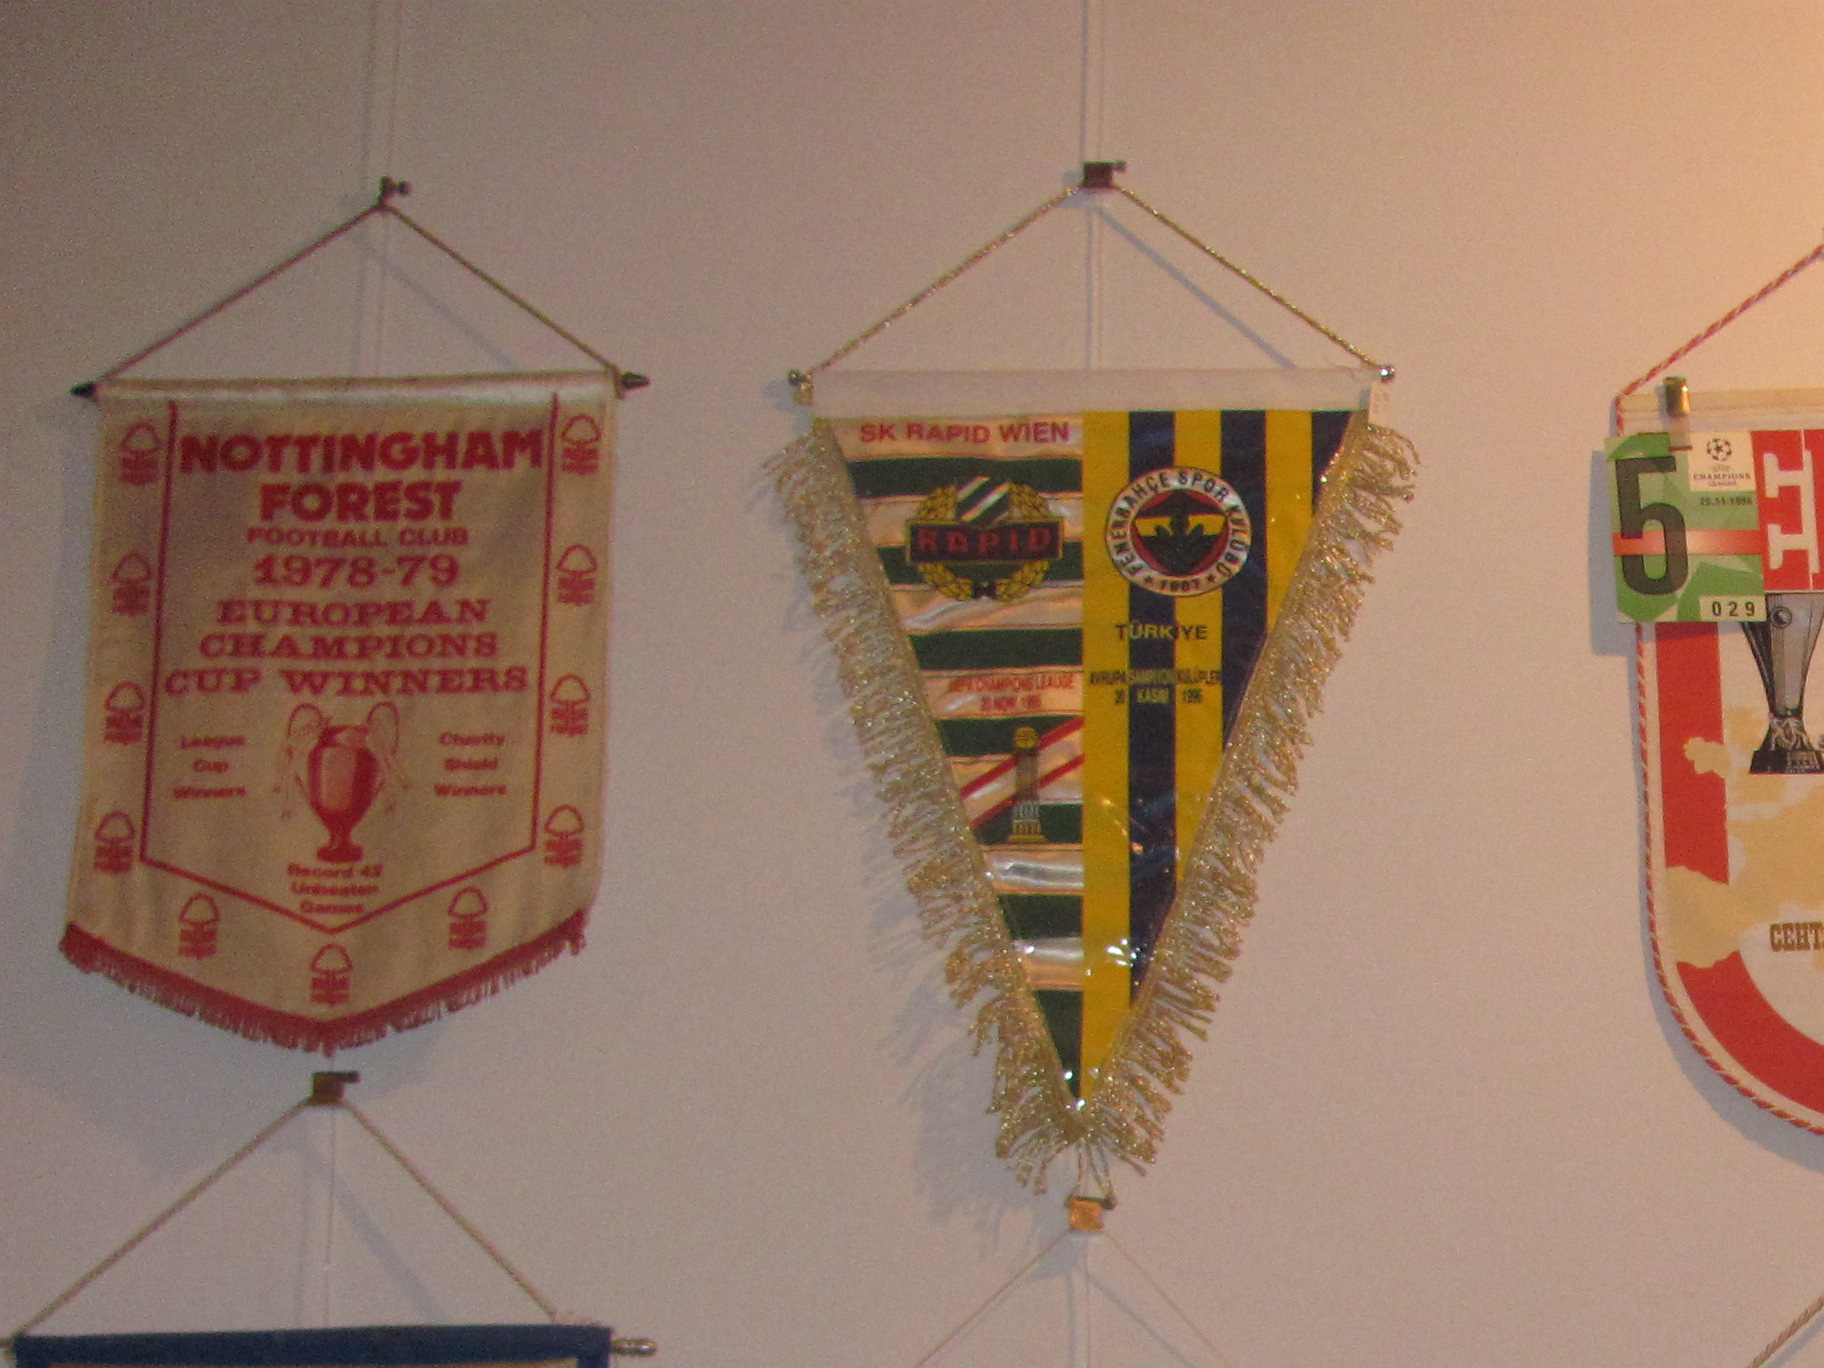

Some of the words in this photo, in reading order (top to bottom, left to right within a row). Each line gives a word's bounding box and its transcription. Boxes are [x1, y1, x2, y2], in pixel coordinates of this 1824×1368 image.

[859, 422, 897, 443] SK
[906, 423, 991, 444] RAPID
[1000, 421, 1071, 444] WIEN
[178, 428, 544, 475] NOTTINGHAM
[1177, 470, 1229, 503] SPOR
[259, 480, 463, 522] FOREST
[1614, 456, 1689, 595] 5
[247, 526, 386, 549] FOOTBALL
[400, 526, 468, 547] CLUB
[916, 525, 1052, 554] RAPID
[254, 553, 459, 590] 1978-79
[215, 598, 488, 628] EUROPEAN
[1711, 600, 1756, 618] 029
[200, 633, 497, 662] CHAMPIONS
[165, 668, 264, 697] CUP
[283, 665, 529, 697] WINNERS
[180, 735, 246, 750] League
[438, 732, 506, 748] Charity
[193, 759, 229, 775] Cup
[444, 757, 498, 771] Shield
[174, 785, 246, 799] Winners
[434, 783, 507, 797] Winners
[287, 863, 354, 877] Record
[300, 901, 364, 914] Games
